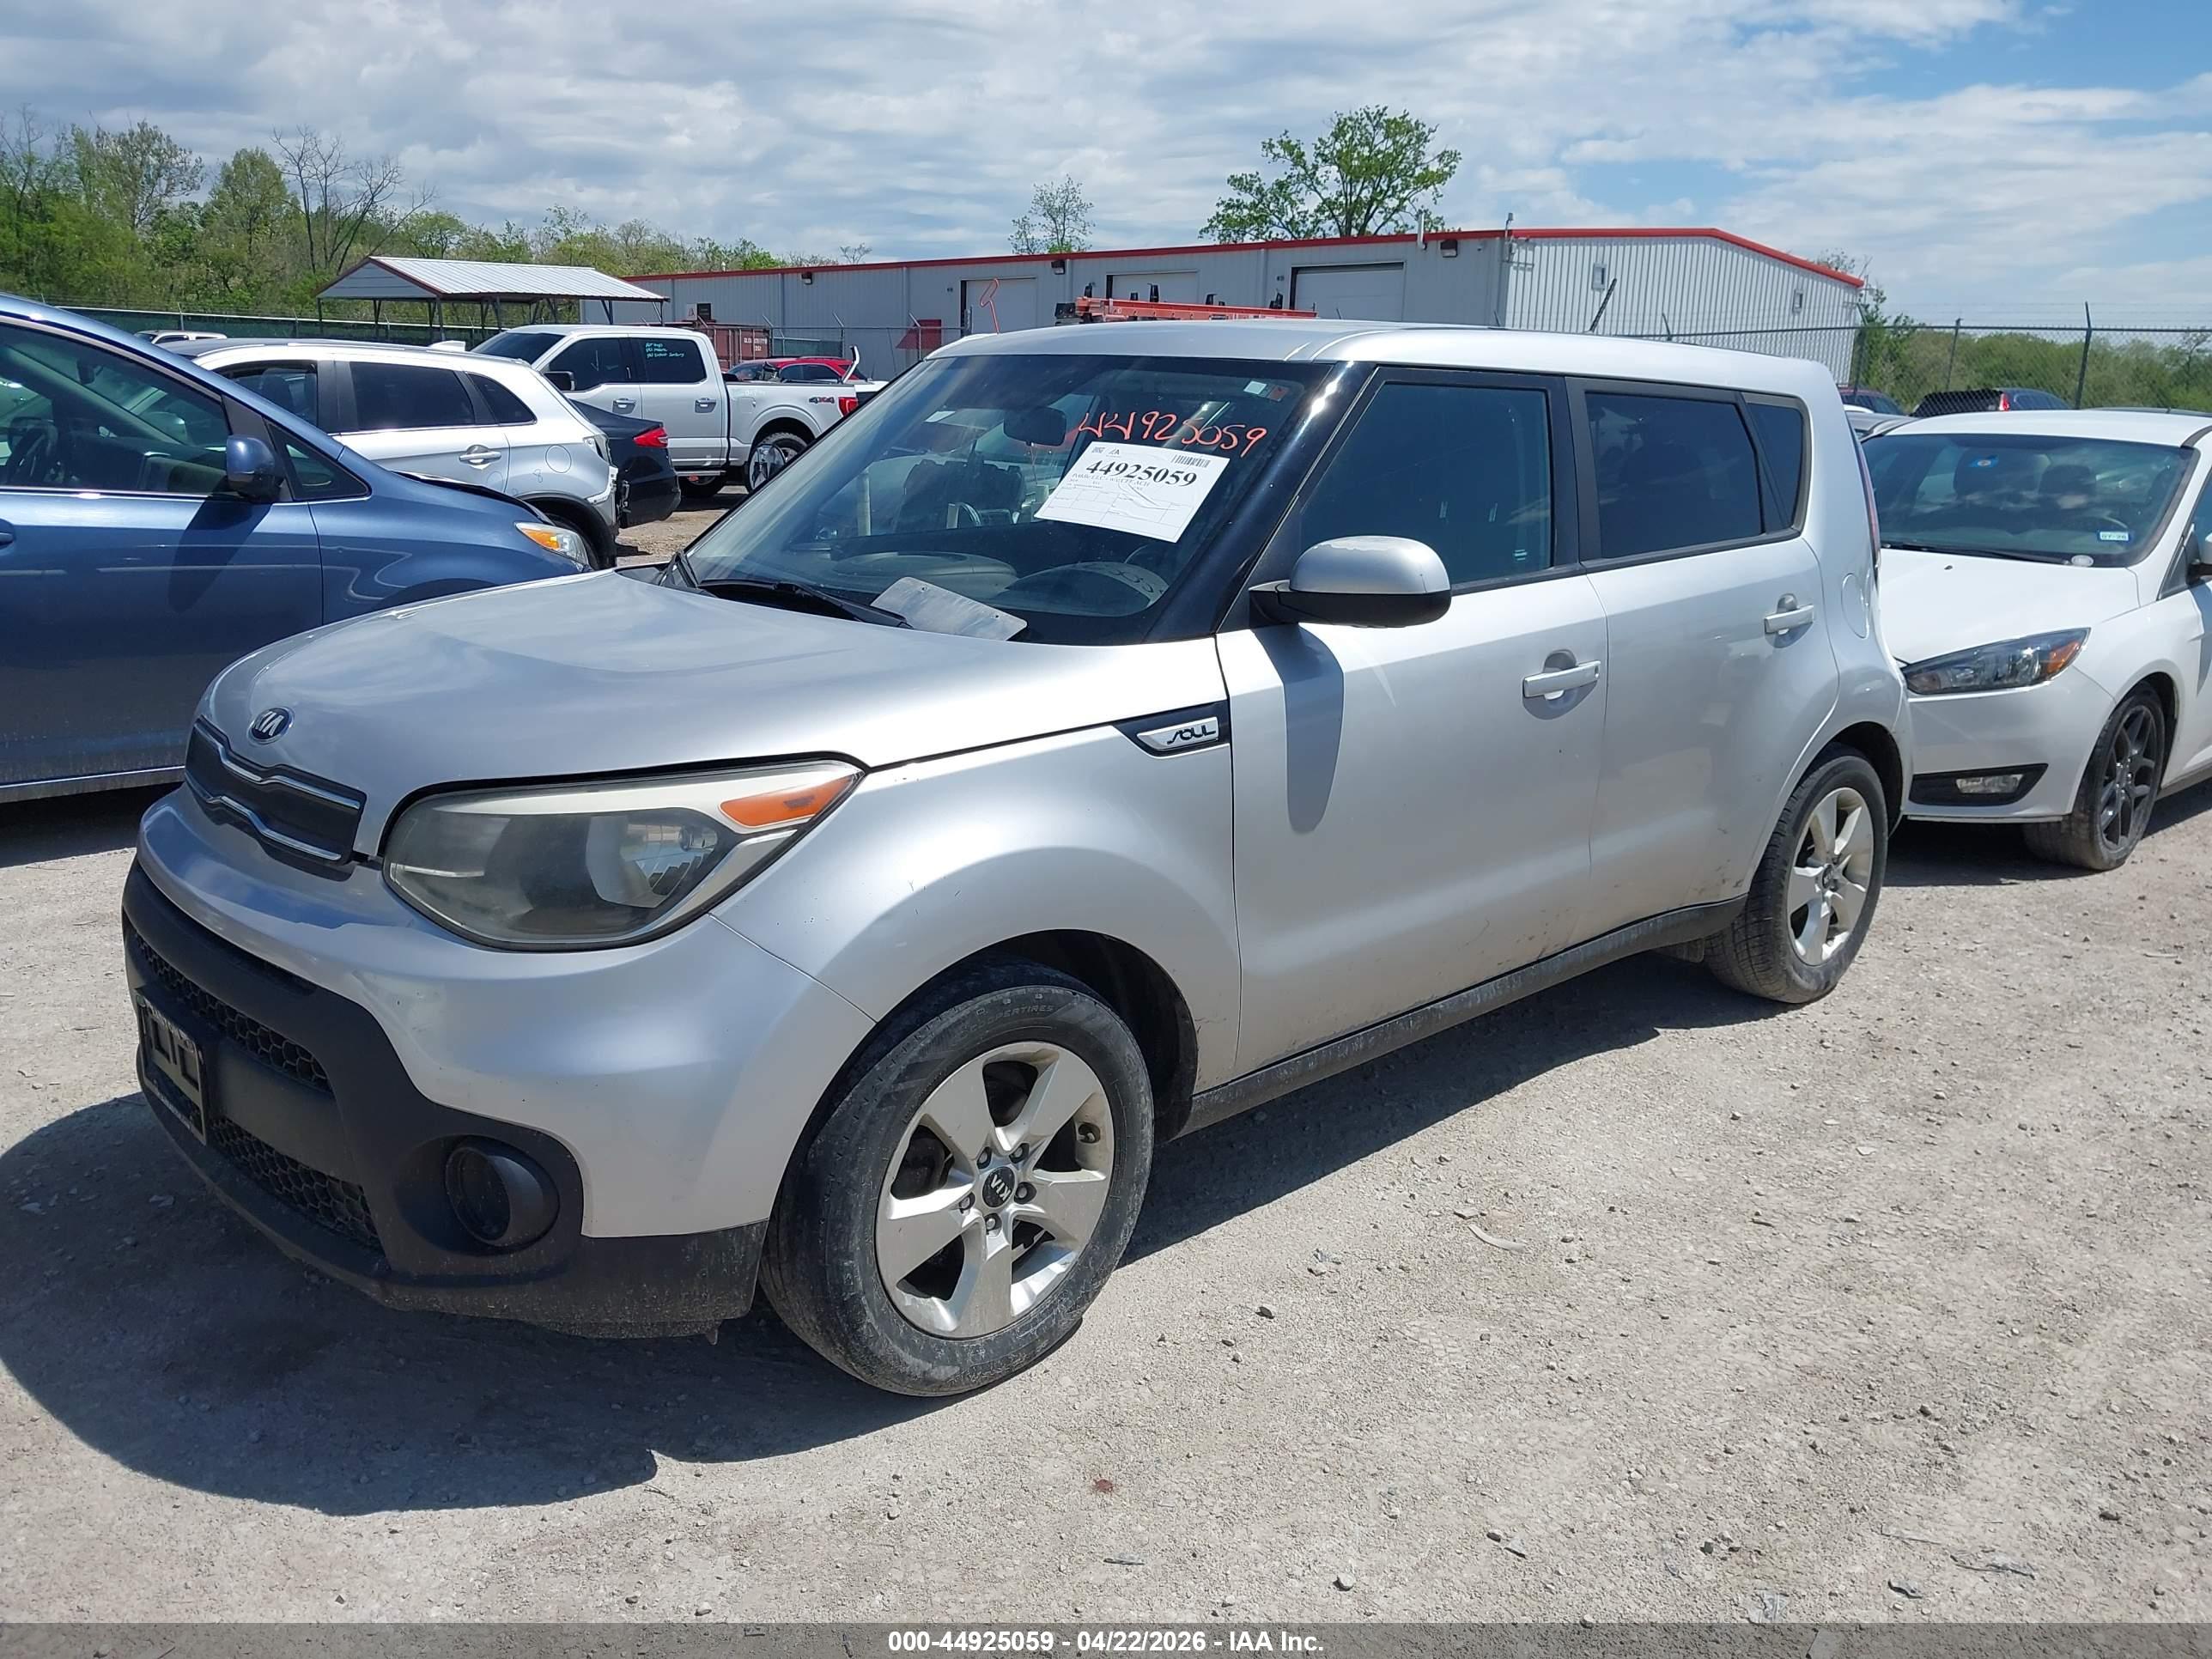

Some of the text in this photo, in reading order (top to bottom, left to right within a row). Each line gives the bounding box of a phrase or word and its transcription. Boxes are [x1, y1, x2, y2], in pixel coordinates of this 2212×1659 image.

[1079, 410, 1267, 459] 44925059
[1085, 460, 1197, 487] 44925059
[1166, 725, 1217, 745] SOUL
[990, 1174, 1012, 1201] KIA
